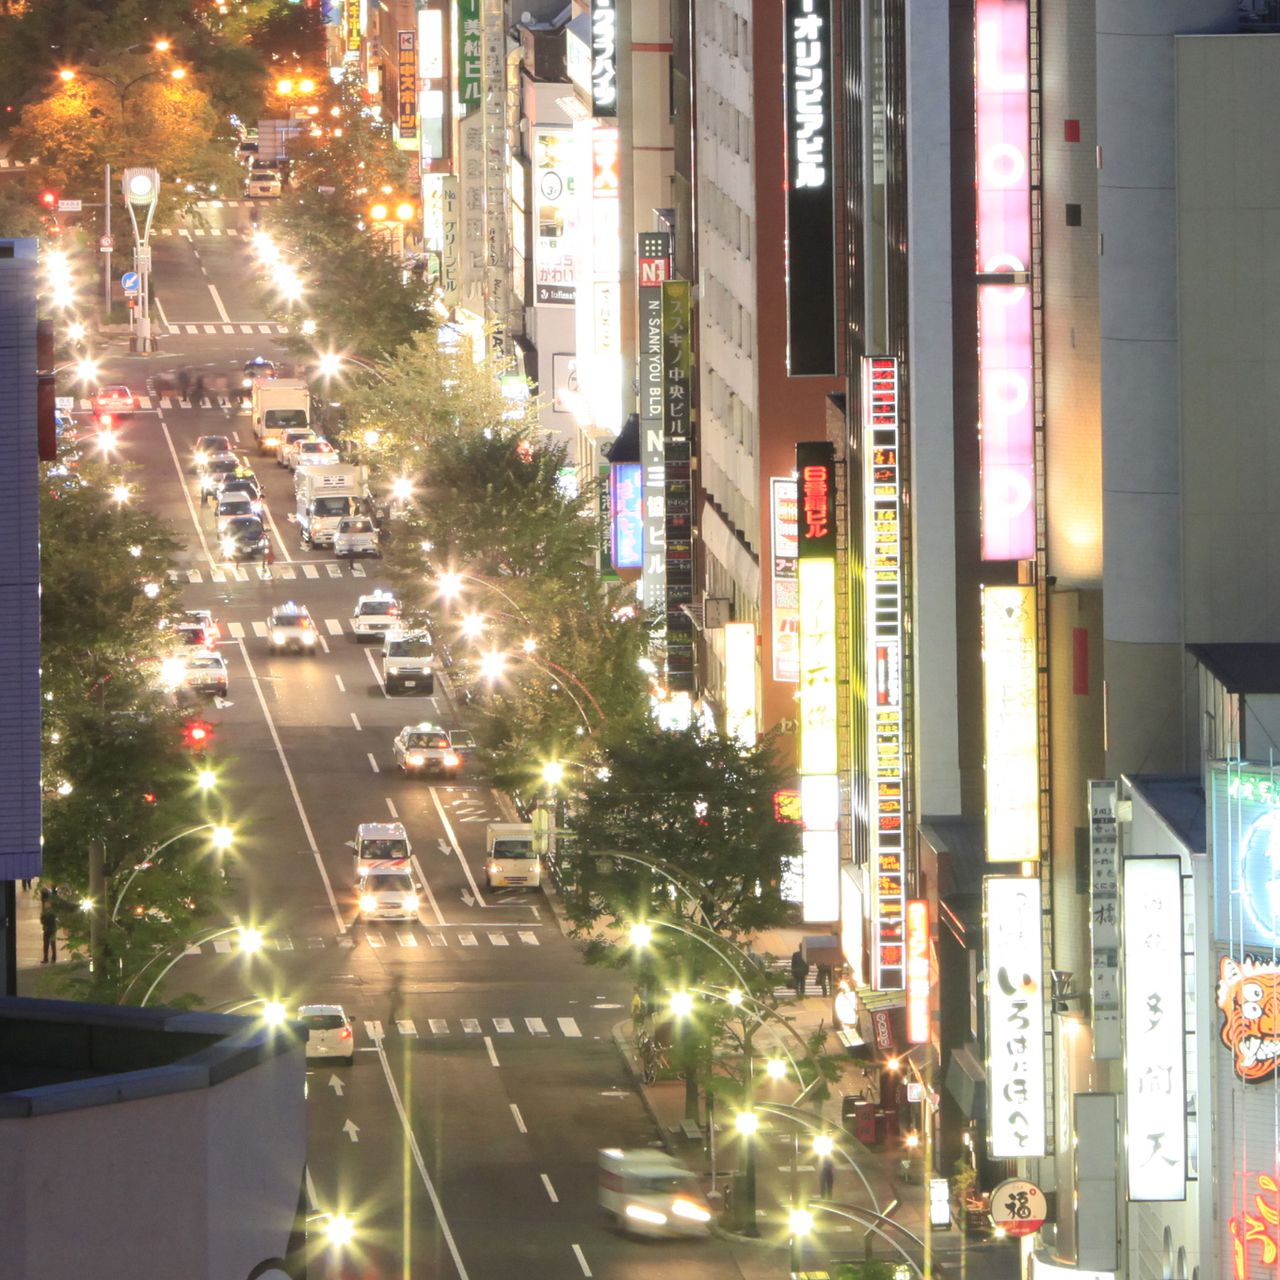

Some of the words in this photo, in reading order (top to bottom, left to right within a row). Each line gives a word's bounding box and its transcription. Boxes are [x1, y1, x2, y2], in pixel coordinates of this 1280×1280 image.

[463, 18, 481, 100] 美松ビル
[444, 220, 457, 292] グリーンビル
[648, 386, 663, 417] BLD.
[669, 299, 686, 435] ススキノ中央ビル
[998, 966, 1036, 1148] いろはにほへと
[1004, 1190, 1032, 1219] 福
